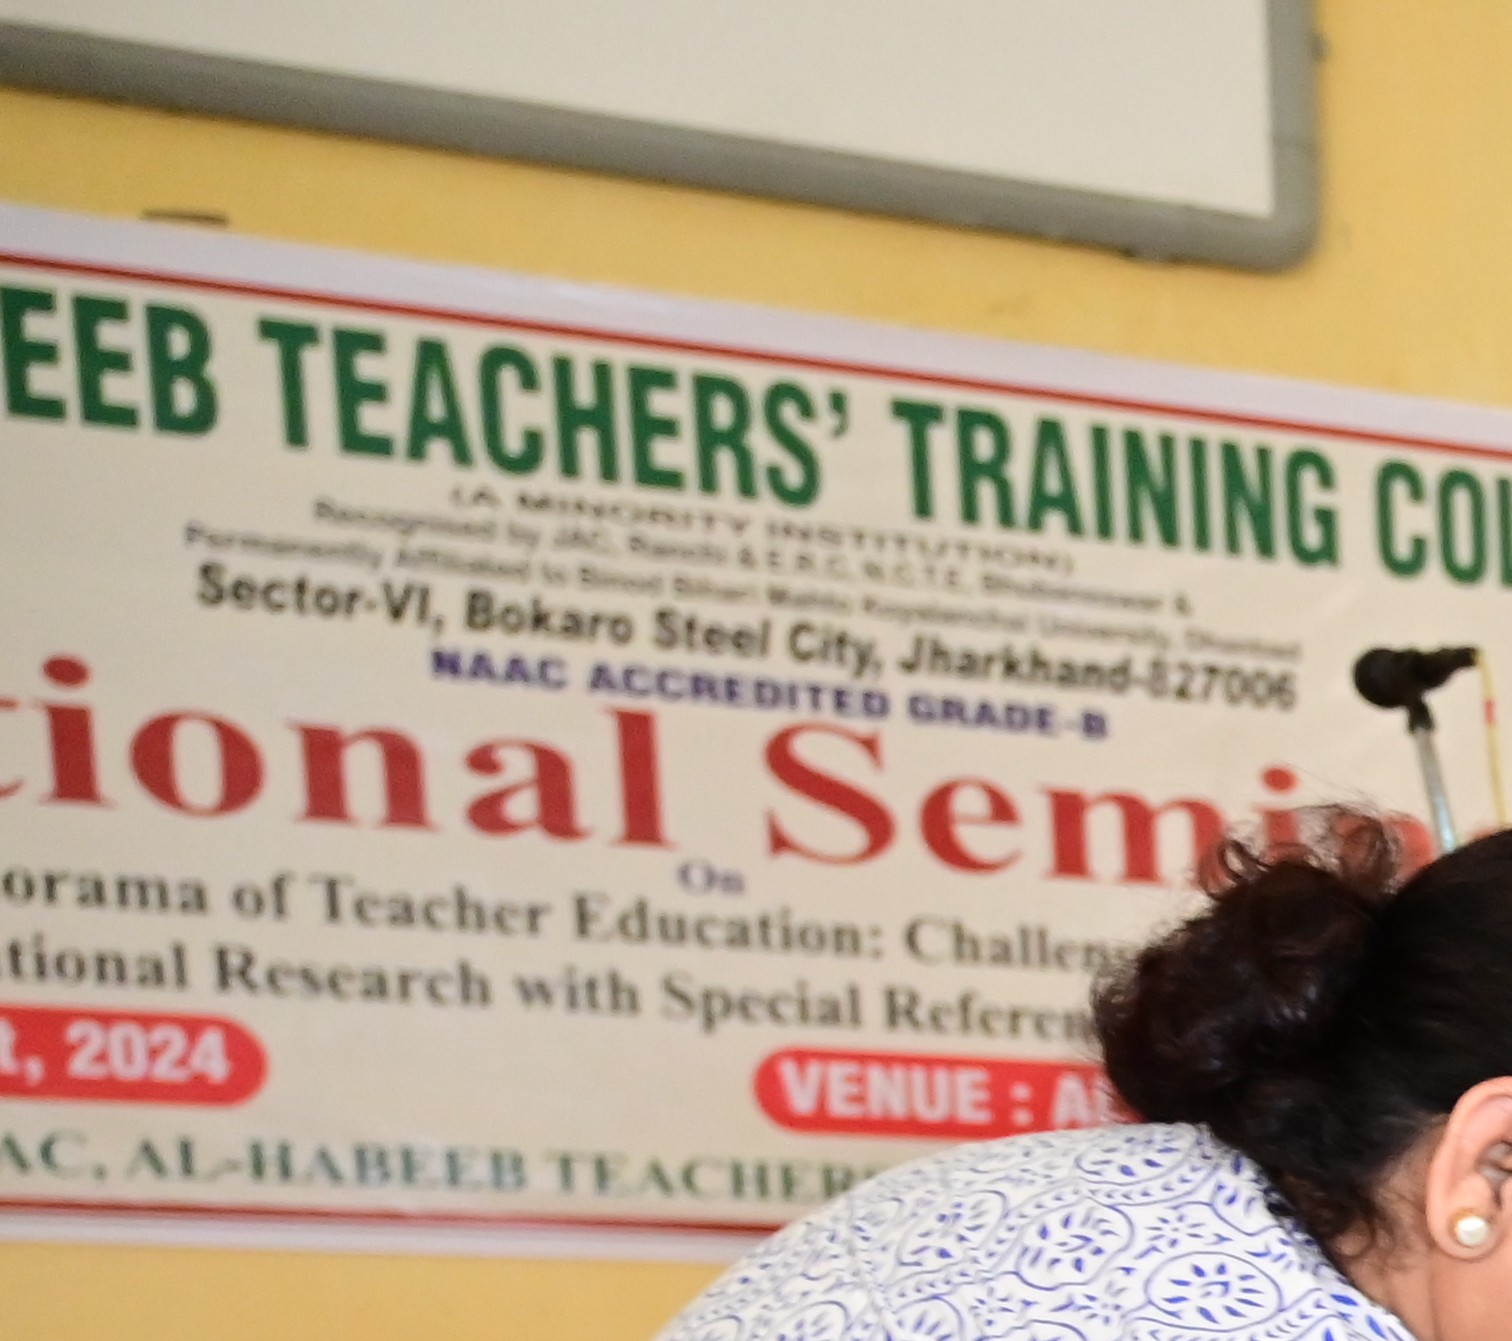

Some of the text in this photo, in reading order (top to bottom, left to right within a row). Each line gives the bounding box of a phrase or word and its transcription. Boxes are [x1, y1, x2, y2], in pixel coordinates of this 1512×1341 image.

[2, 284, 220, 436] EEB
[256, 314, 850, 508] TEACHERS'
[889, 396, 1340, 569] TRAINING
[517, 491, 750, 537] MINORITY
[198, 560, 1298, 713] Sector-VI, Bokaro Steel City, Jharkhand-827006
[430, 649, 568, 690] NAAC
[588, 662, 891, 719] ACCREDITED
[676, 858, 745, 898] On
[232, 869, 297, 919] of
[308, 871, 554, 939] Teacher
[572, 891, 886, 963] Education:
[212, 942, 494, 1008] Research
[513, 964, 640, 1018] with
[659, 972, 864, 1038] Special
[64, 1016, 233, 1084] 2024
[776, 1057, 992, 1126] VENUE
[127, 1132, 529, 1193] AL-HABEEB
